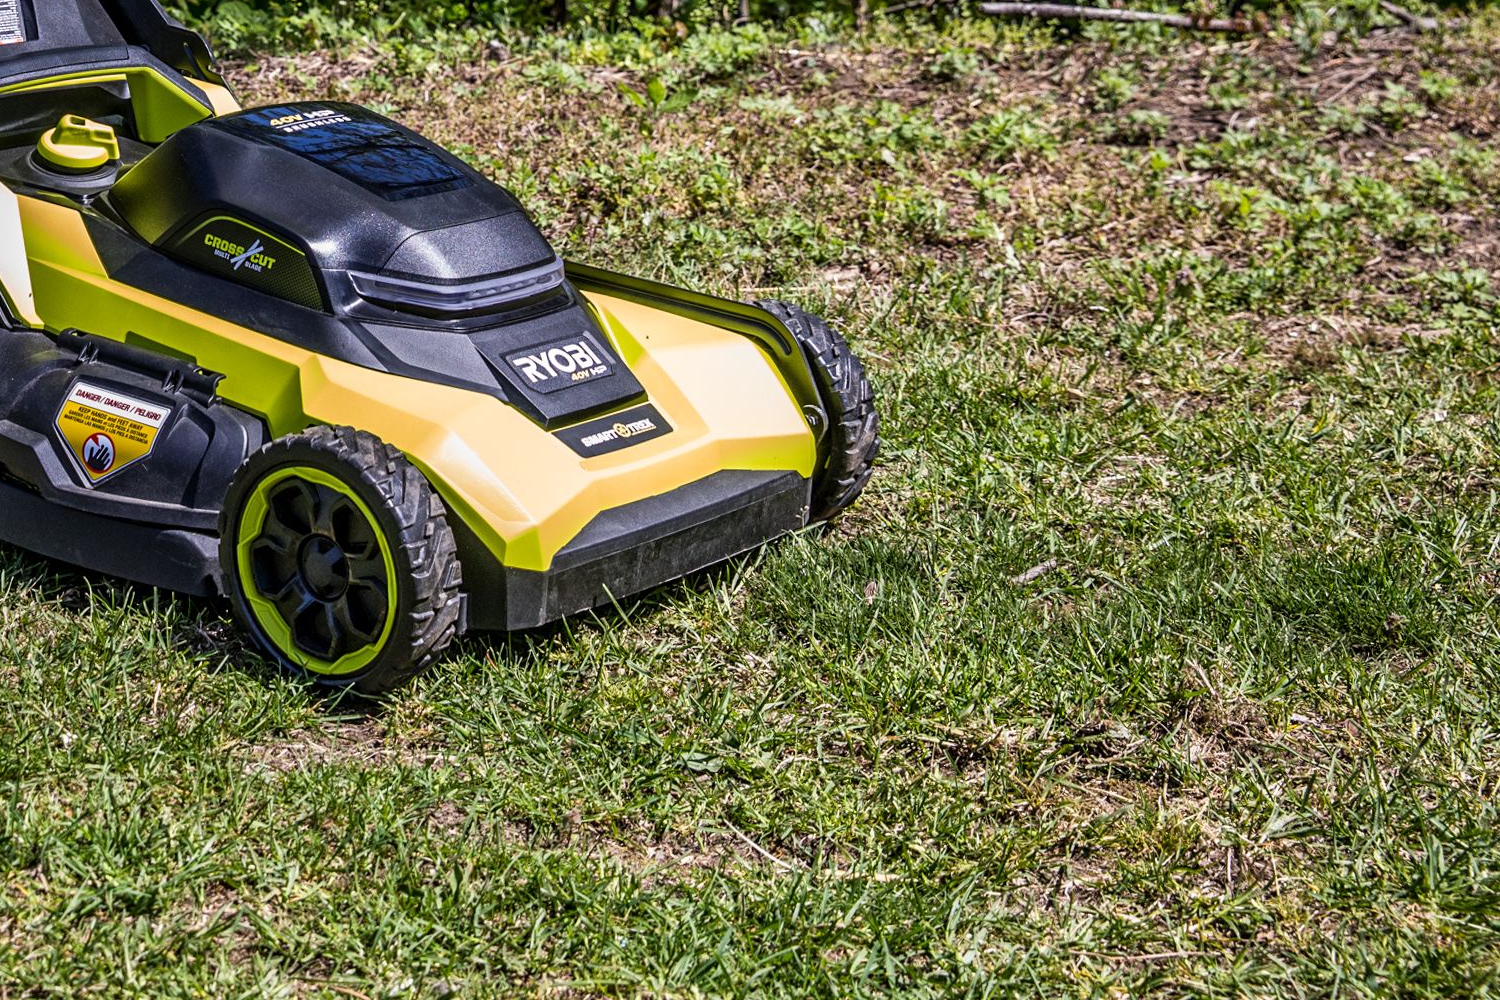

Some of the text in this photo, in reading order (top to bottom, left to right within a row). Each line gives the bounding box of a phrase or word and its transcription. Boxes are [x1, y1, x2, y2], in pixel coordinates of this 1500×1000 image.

[270, 114, 304, 126] 40V
[283, 116, 352, 133] BRUSHLESS
[204, 233, 277, 270] CROSS CUT
[213, 249, 262, 273] MULTI BLADE
[513, 341, 602, 383] RYOBI
[571, 364, 608, 381] 40V HP
[76, 389, 101, 402] DANGER
[104, 398, 130, 411] DANGER
[135, 408, 161, 421] PELIGRO
[91, 410, 107, 419] HANDS
[117, 418, 129, 426] FEET
[129, 422, 143, 430] AWAY
[581, 418, 656, 447] SMART TREK
